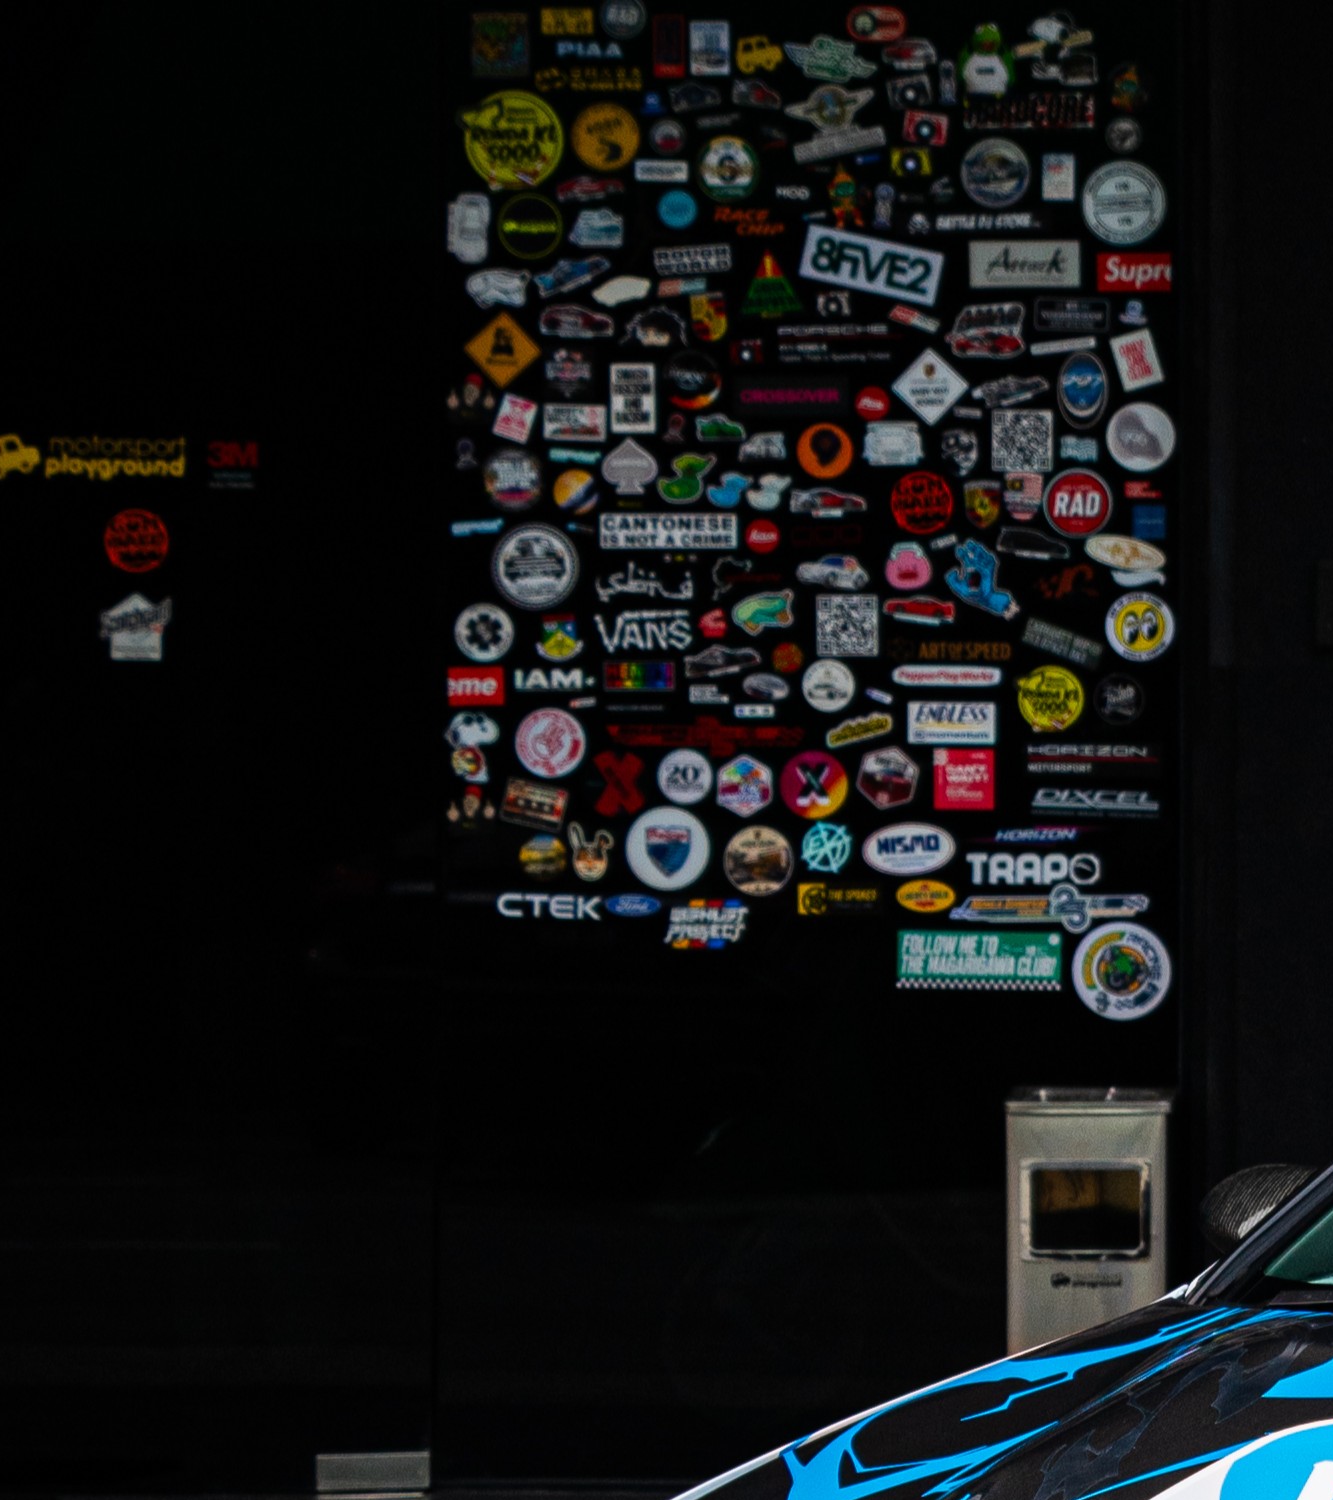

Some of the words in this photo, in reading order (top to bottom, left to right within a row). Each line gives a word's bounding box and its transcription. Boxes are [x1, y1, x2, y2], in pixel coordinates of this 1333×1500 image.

[811, 235, 933, 296] 8FIVE2
[48, 434, 189, 457] motorsport
[45, 456, 187, 481] playground
[1053, 490, 1102, 518] RAD
[603, 518, 733, 531] CANTONESE
[603, 533, 618, 545] IS
[625, 533, 658, 545] NOT
[666, 533, 675, 545] A
[681, 533, 733, 545] CRIME
[593, 609, 694, 653] VANS
[1030, 786, 1161, 811] DIXCEL
[877, 835, 940, 854] NISMO
[496, 891, 602, 921] CTEK
[902, 933, 956, 956] FOLLOW
[959, 934, 979, 956] ME
[981, 934, 1000, 956] TO
[901, 955, 926, 976] THE
